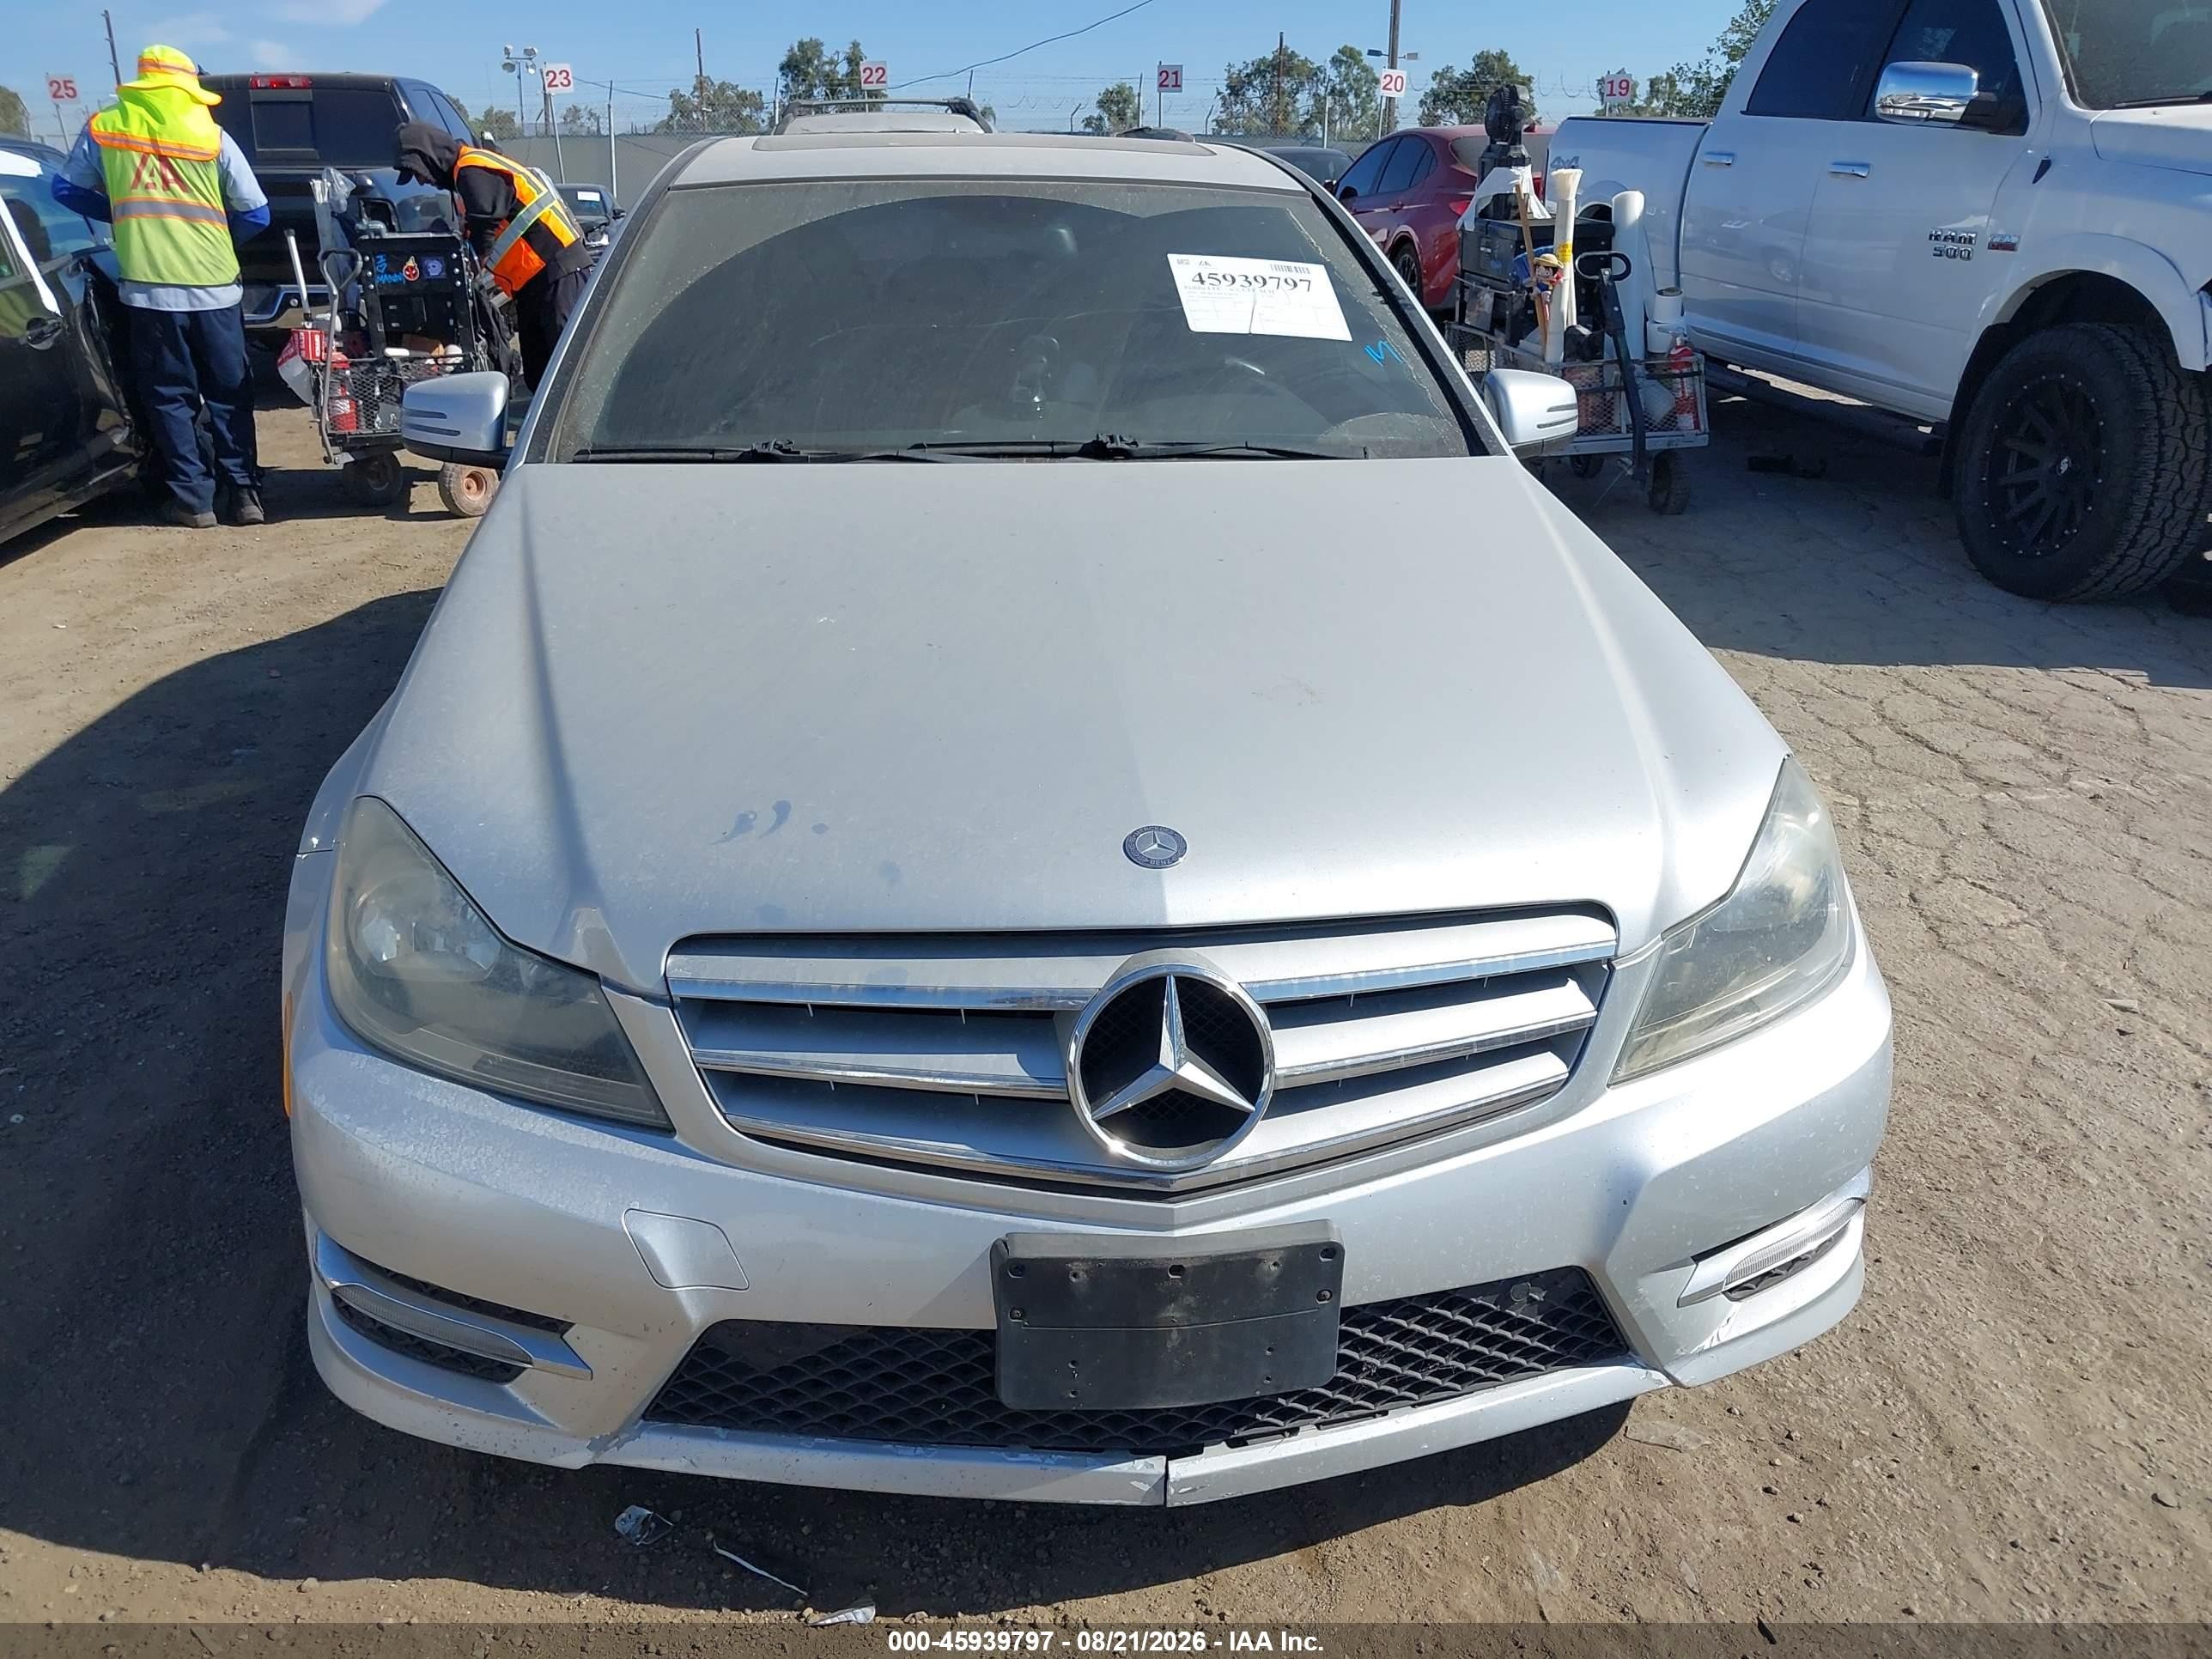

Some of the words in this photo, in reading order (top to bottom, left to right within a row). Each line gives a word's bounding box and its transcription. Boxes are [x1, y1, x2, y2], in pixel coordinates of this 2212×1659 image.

[545, 70, 572, 88] 23
[862, 66, 887, 84] 22
[1158, 70, 1182, 88] 21
[1382, 74, 1404, 93] 20
[49, 79, 77, 99] 25
[1606, 78, 1630, 97] 19
[1929, 229, 1978, 246] RAM
[1191, 271, 1312, 293] 45939797
